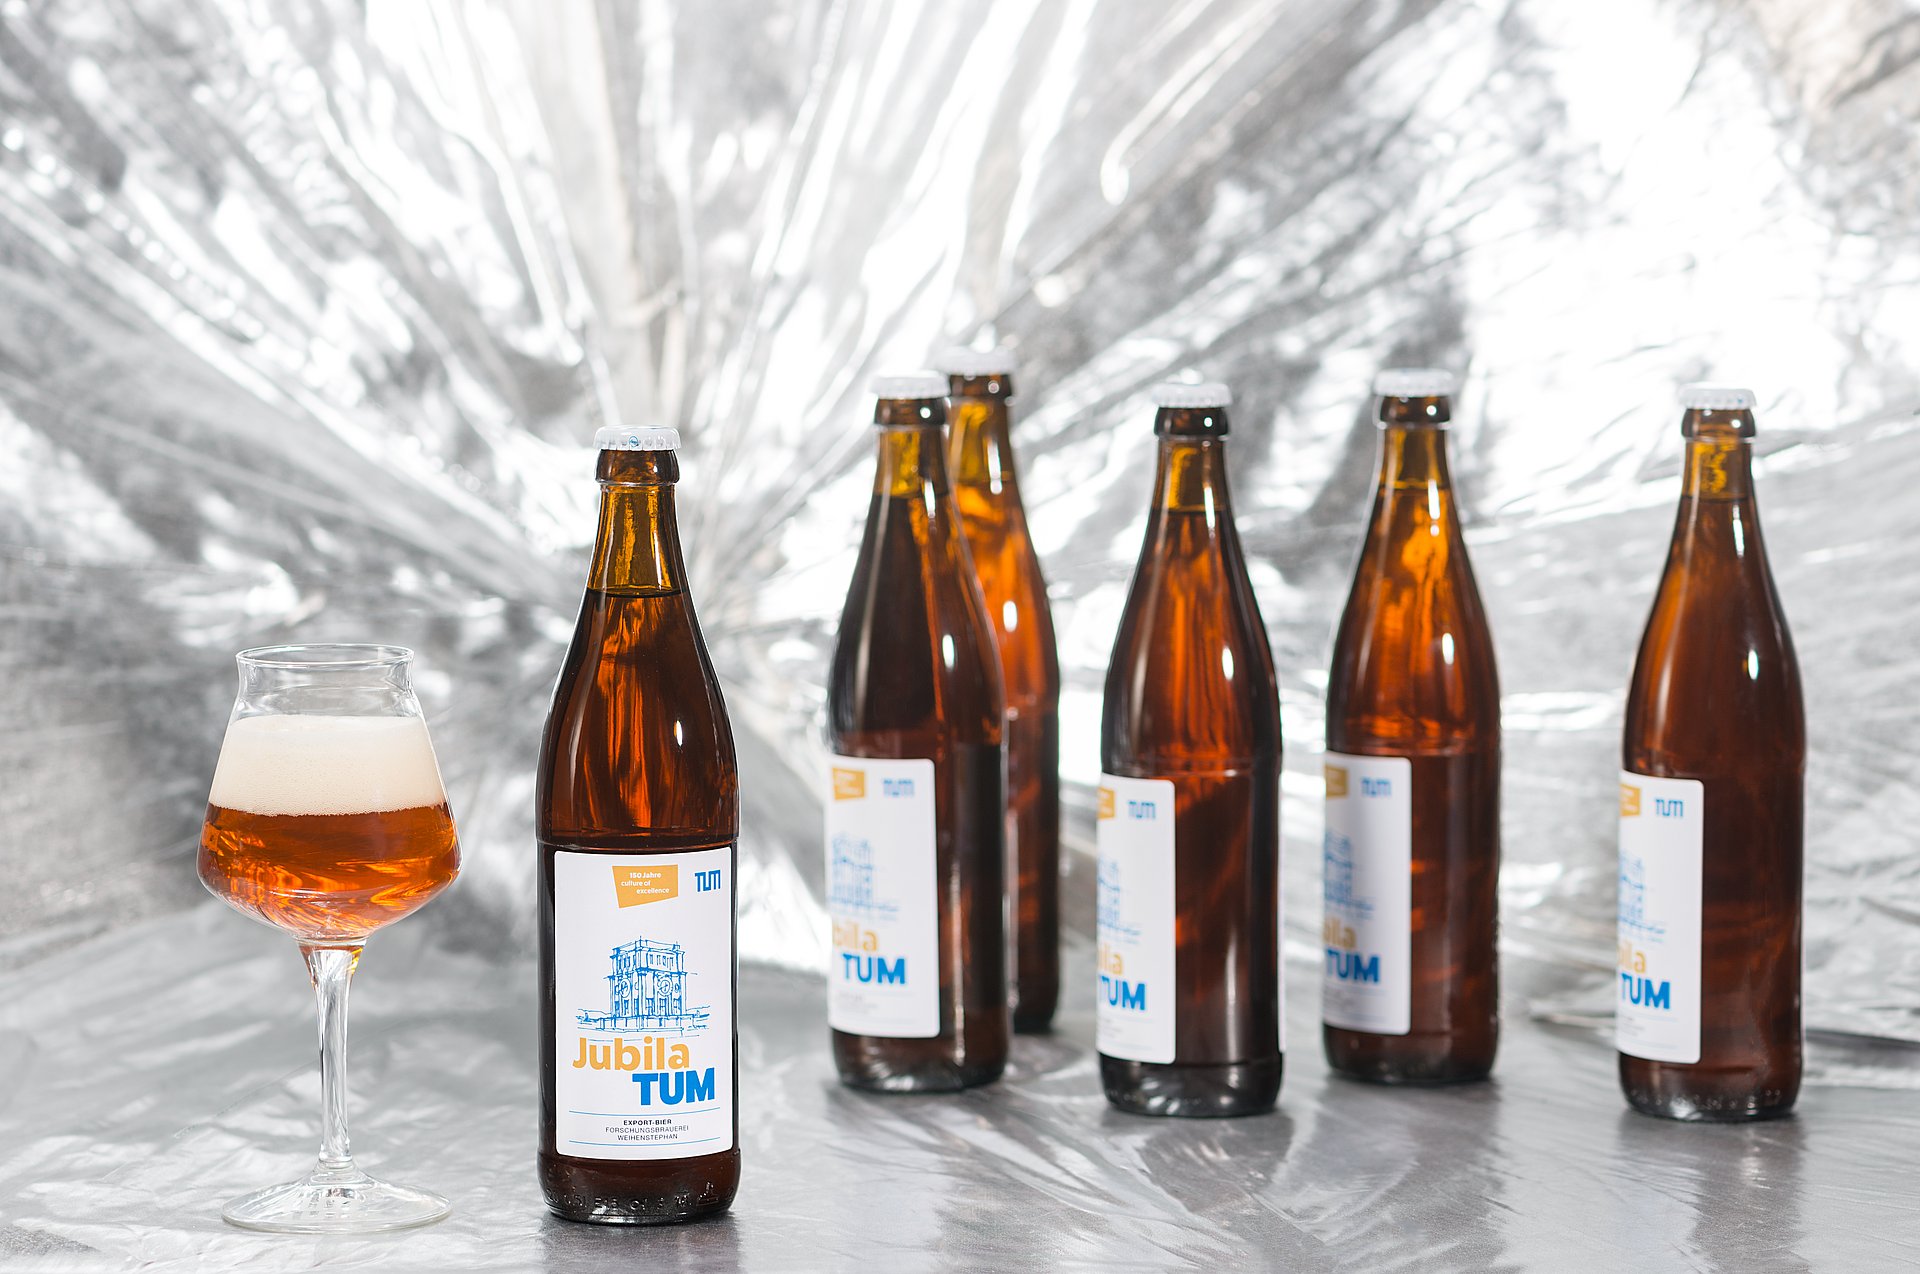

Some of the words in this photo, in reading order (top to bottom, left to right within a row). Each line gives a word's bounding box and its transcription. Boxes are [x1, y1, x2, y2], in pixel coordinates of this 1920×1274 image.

[636, 887, 671, 895] excellence
[694, 869, 721, 893] TUM
[842, 953, 906, 985] TUM
[1326, 948, 1379, 983] TUM
[1620, 972, 1670, 1010] TUM
[572, 1036, 690, 1071] Jubila
[632, 1067, 715, 1106] TUM
[605, 1125, 689, 1134] FORSCHUNGSBRAUEREI
[617, 1133, 678, 1141] WEIHENSTEPHAN
